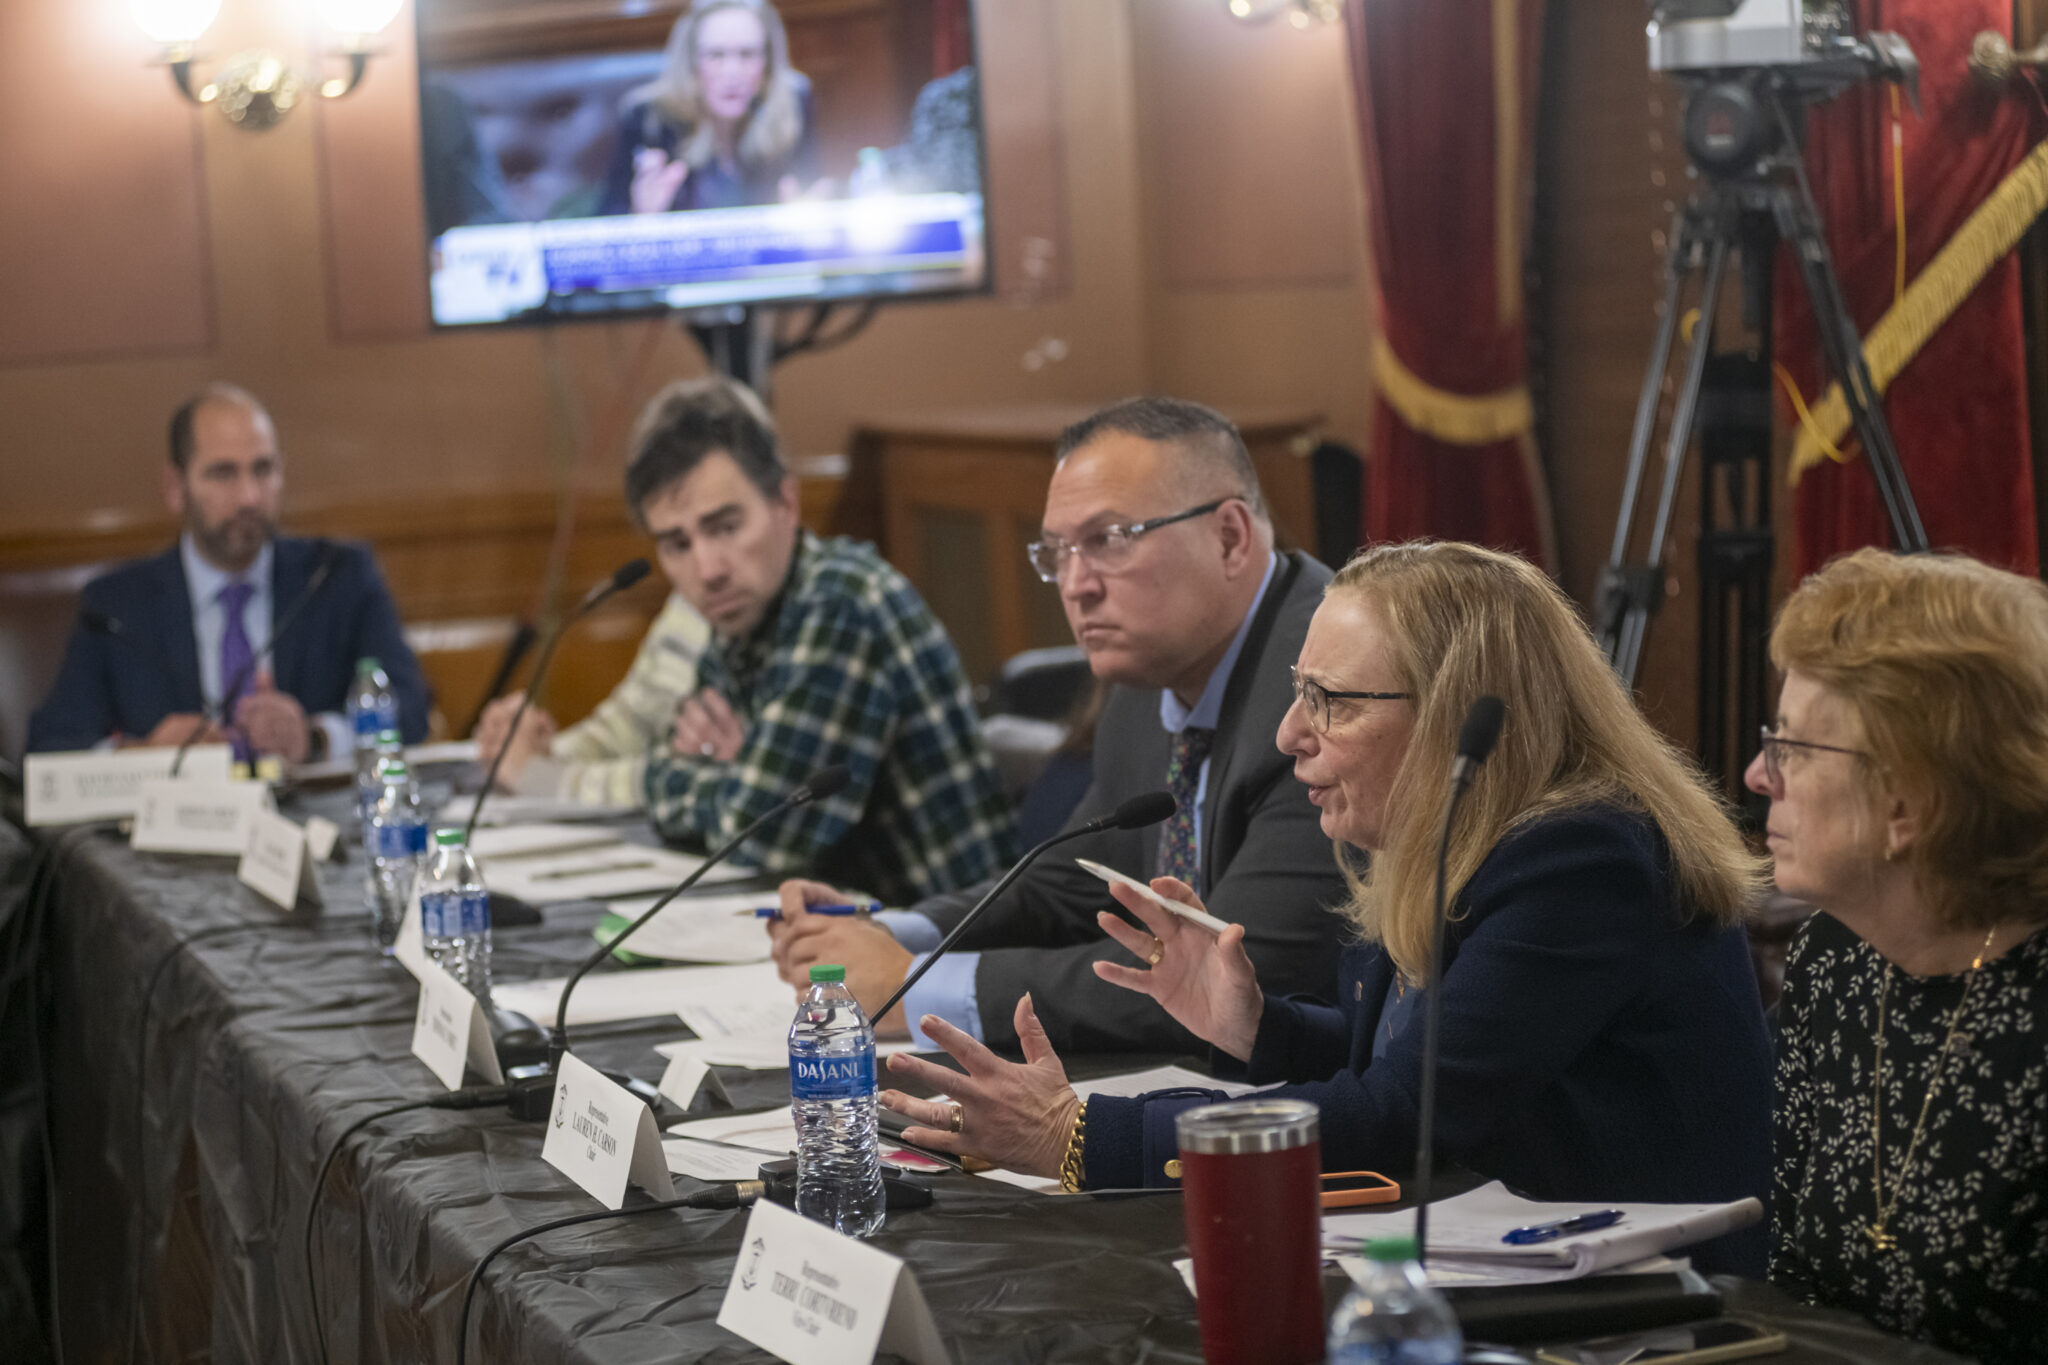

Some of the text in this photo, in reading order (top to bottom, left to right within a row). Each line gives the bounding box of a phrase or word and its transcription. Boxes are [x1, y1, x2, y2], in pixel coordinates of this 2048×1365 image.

[798, 1060, 859, 1083] DASANI
[572, 1111, 592, 1139] LAUREN
[598, 1129, 616, 1157] CARSON
